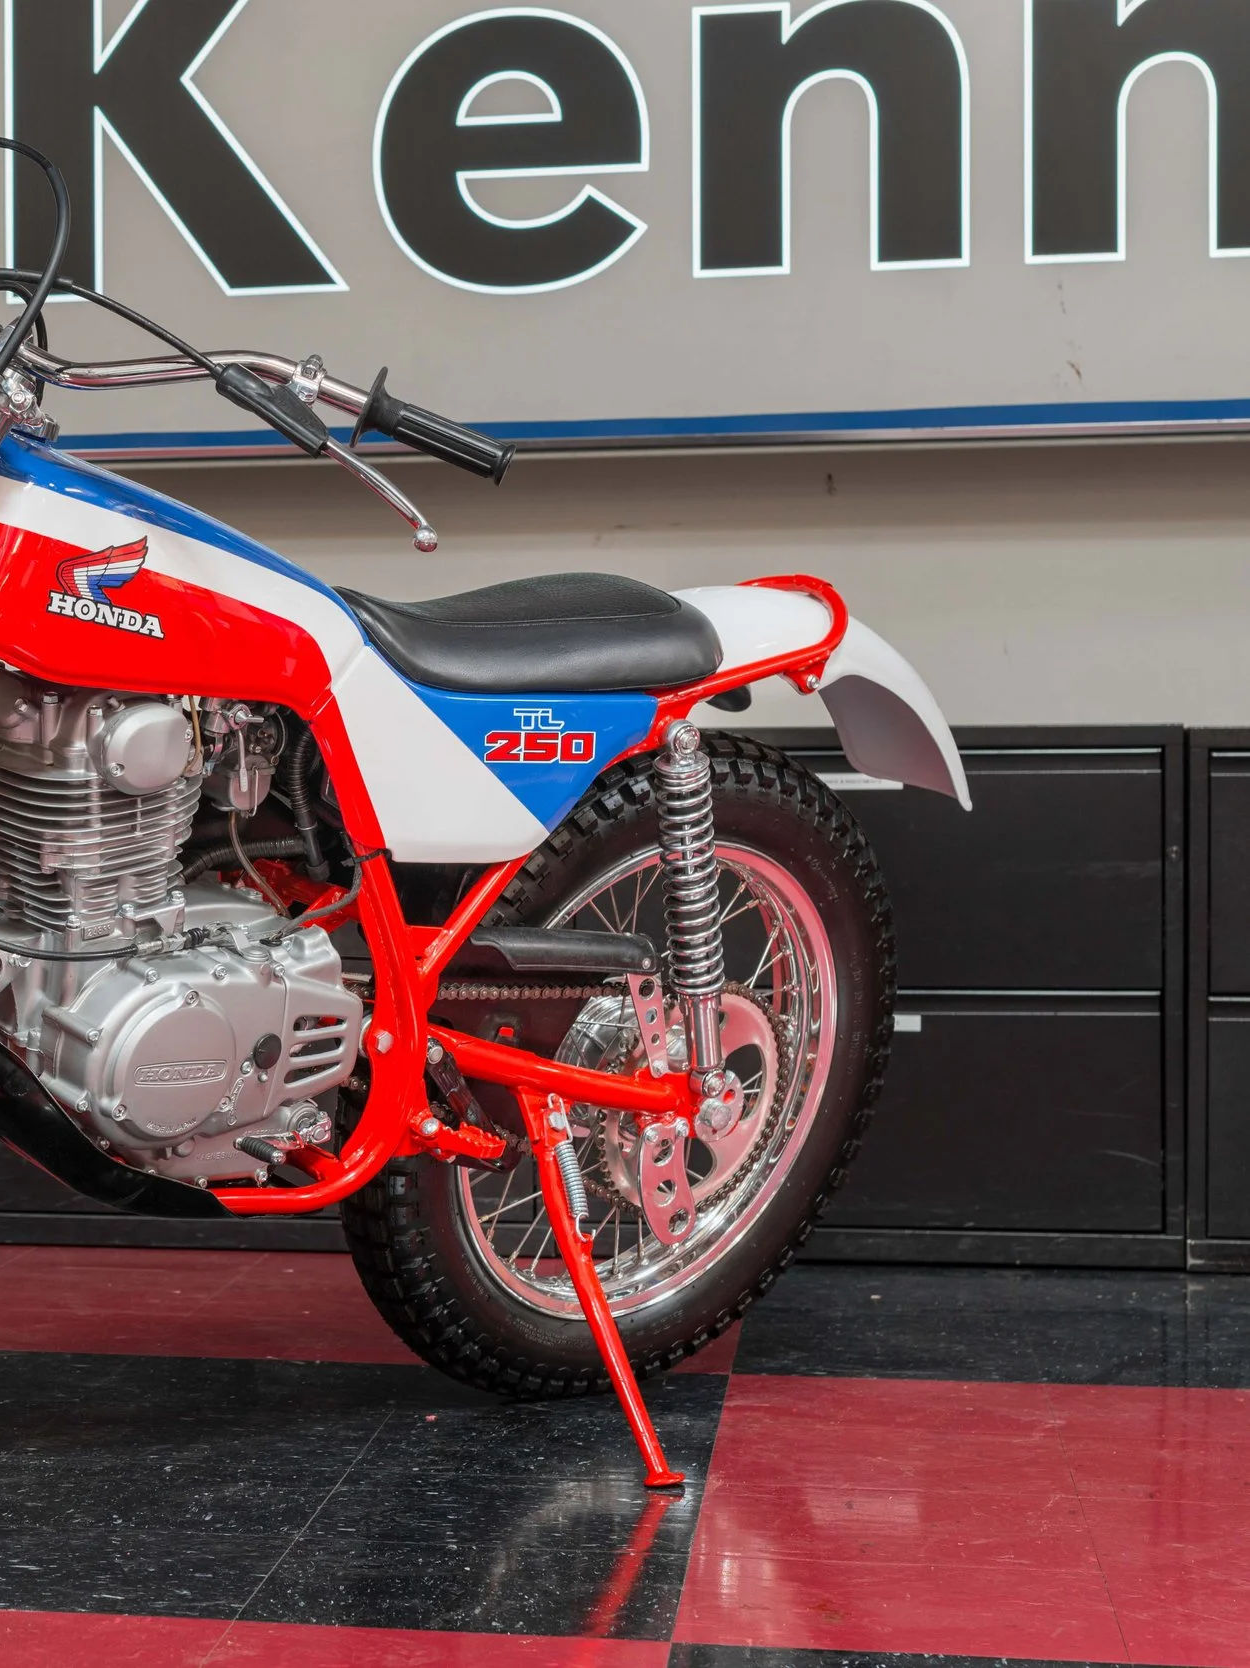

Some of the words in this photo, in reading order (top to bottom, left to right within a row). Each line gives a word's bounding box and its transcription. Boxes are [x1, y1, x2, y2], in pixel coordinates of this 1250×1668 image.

[46, 590, 165, 640] HONDA
[513, 708, 565, 730] TL
[484, 730, 596, 764] 250
[139, 1063, 221, 1083] HONDA
[145, 1119, 166, 1133] MADE
[165, 1125, 174, 1134] IN
[174, 1117, 197, 1133] JAPAN
